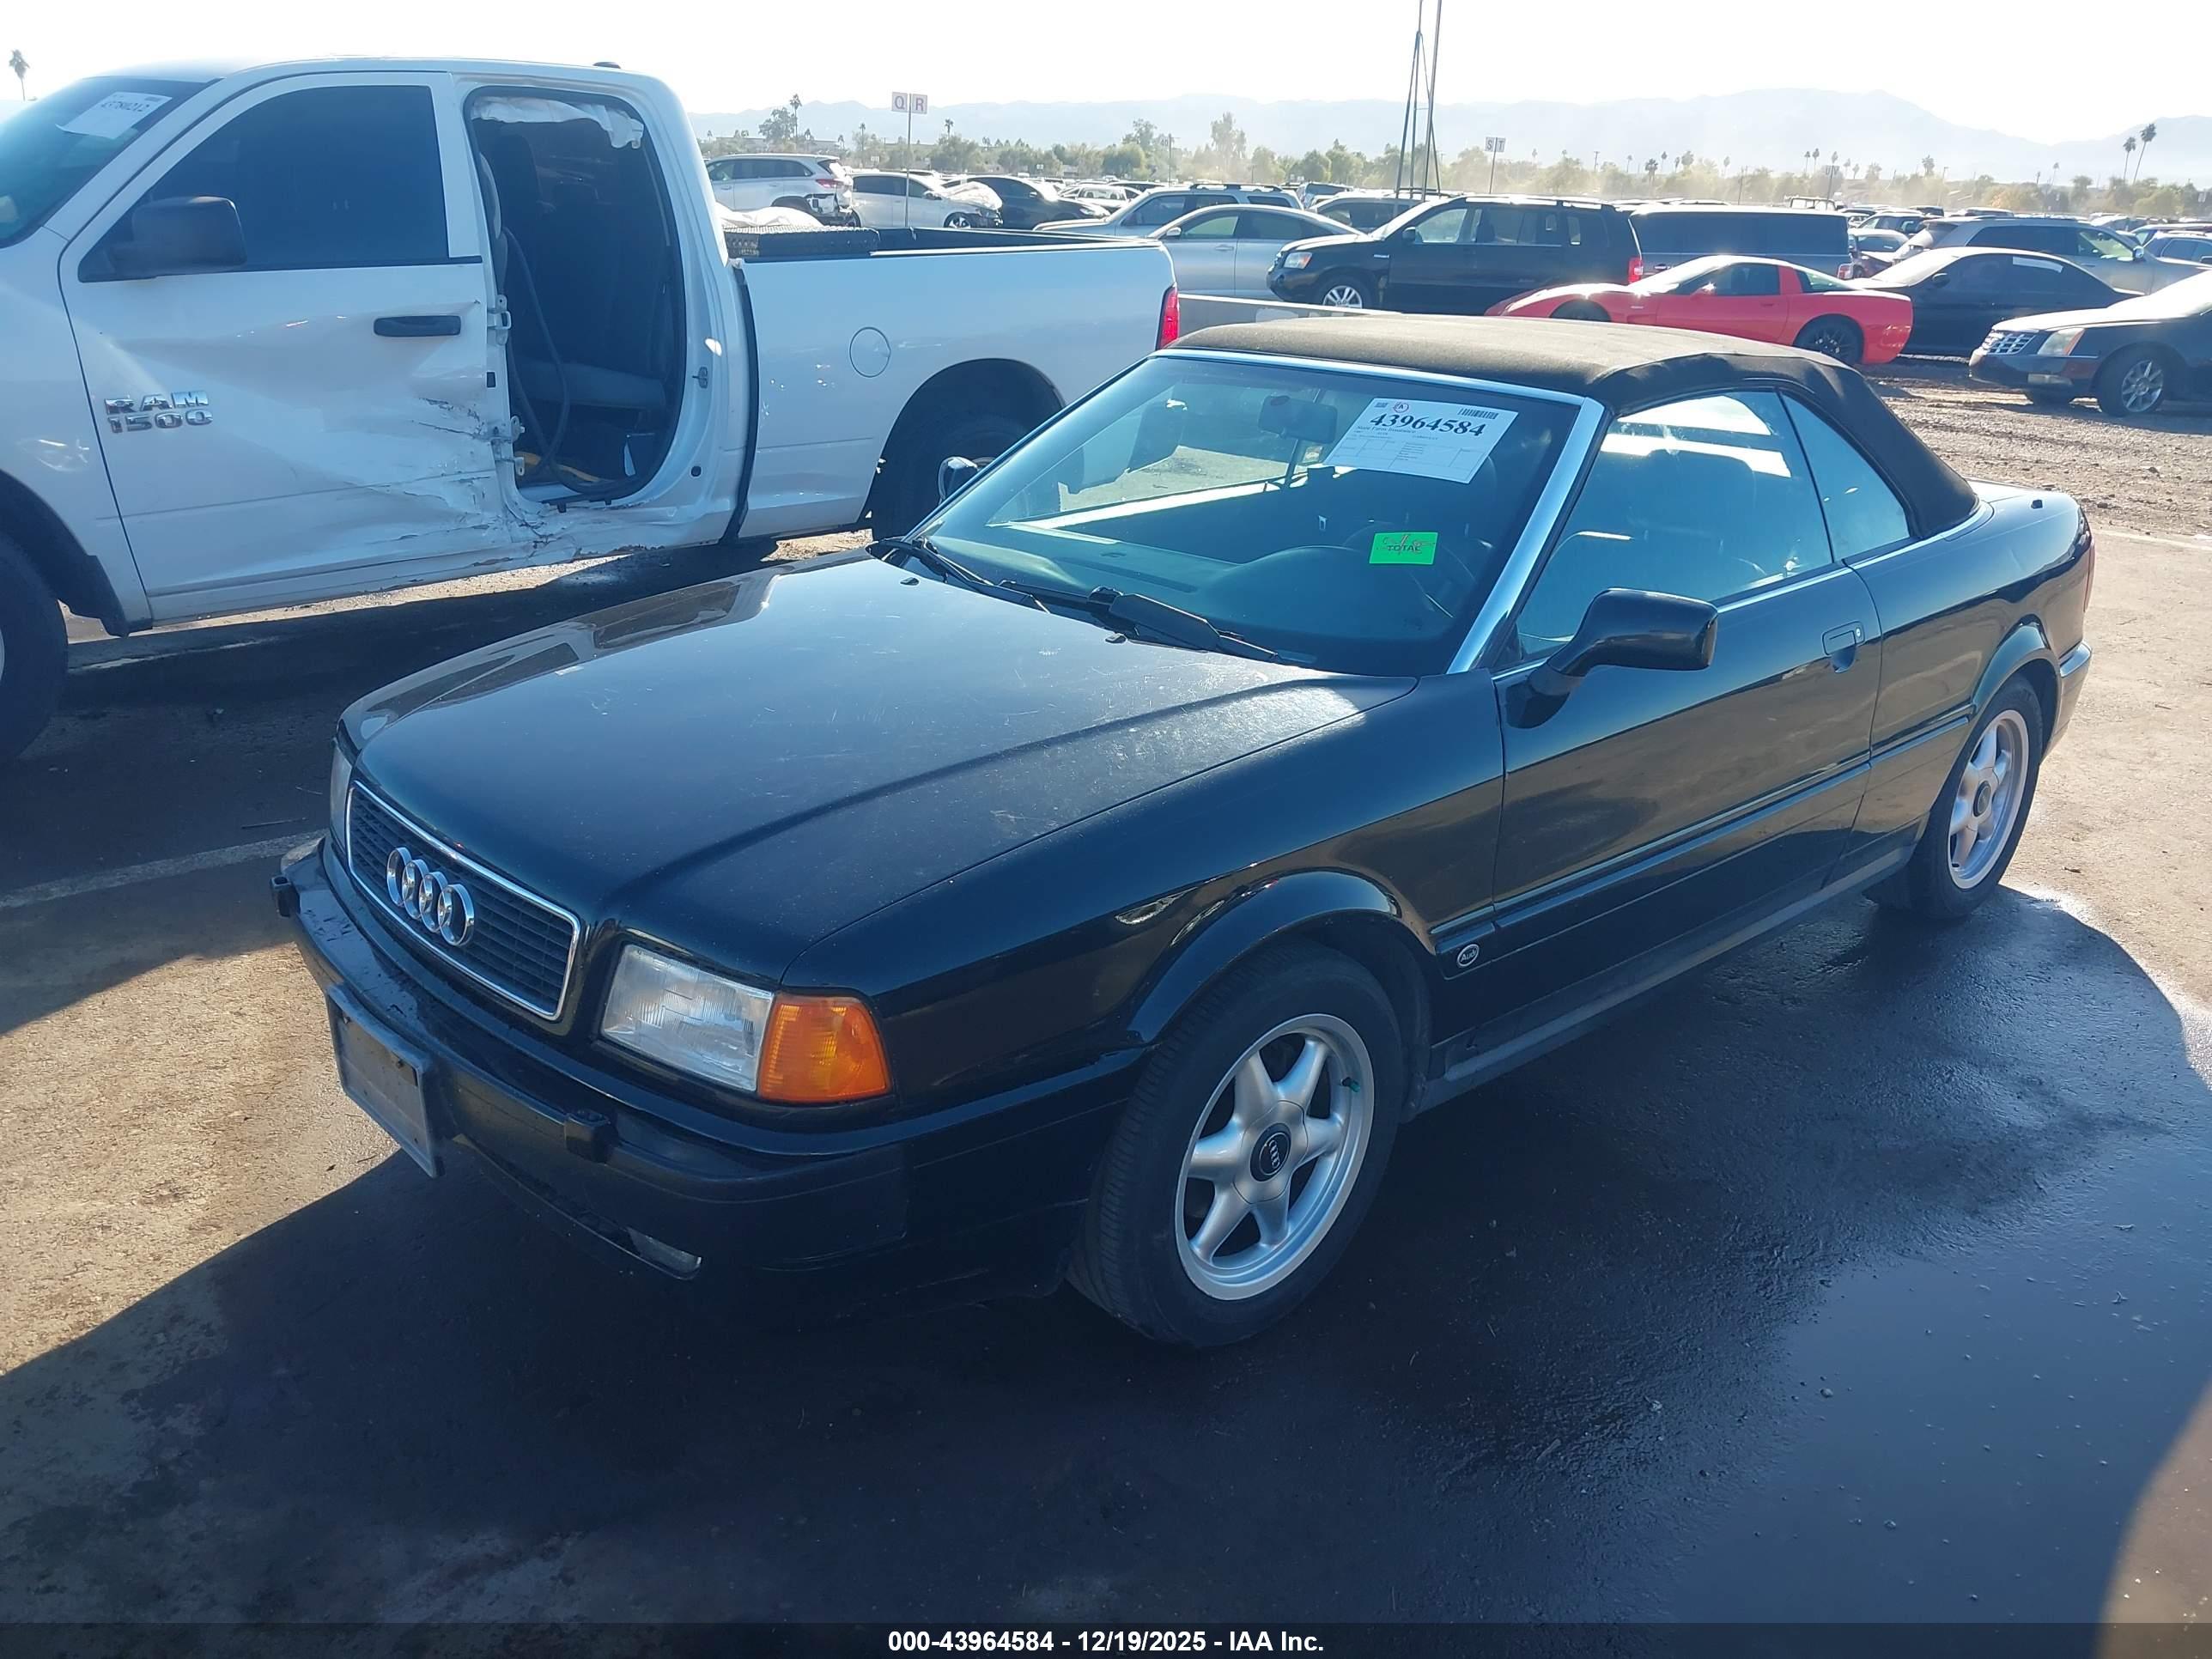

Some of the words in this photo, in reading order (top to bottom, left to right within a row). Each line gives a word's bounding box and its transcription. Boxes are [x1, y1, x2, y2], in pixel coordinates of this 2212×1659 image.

[894, 95, 905, 110] Q
[915, 97, 924, 112] R
[1498, 140, 1504, 150] T
[104, 390, 209, 415] RAM
[107, 409, 213, 433] 1500
[1370, 413, 1486, 436] 43964584
